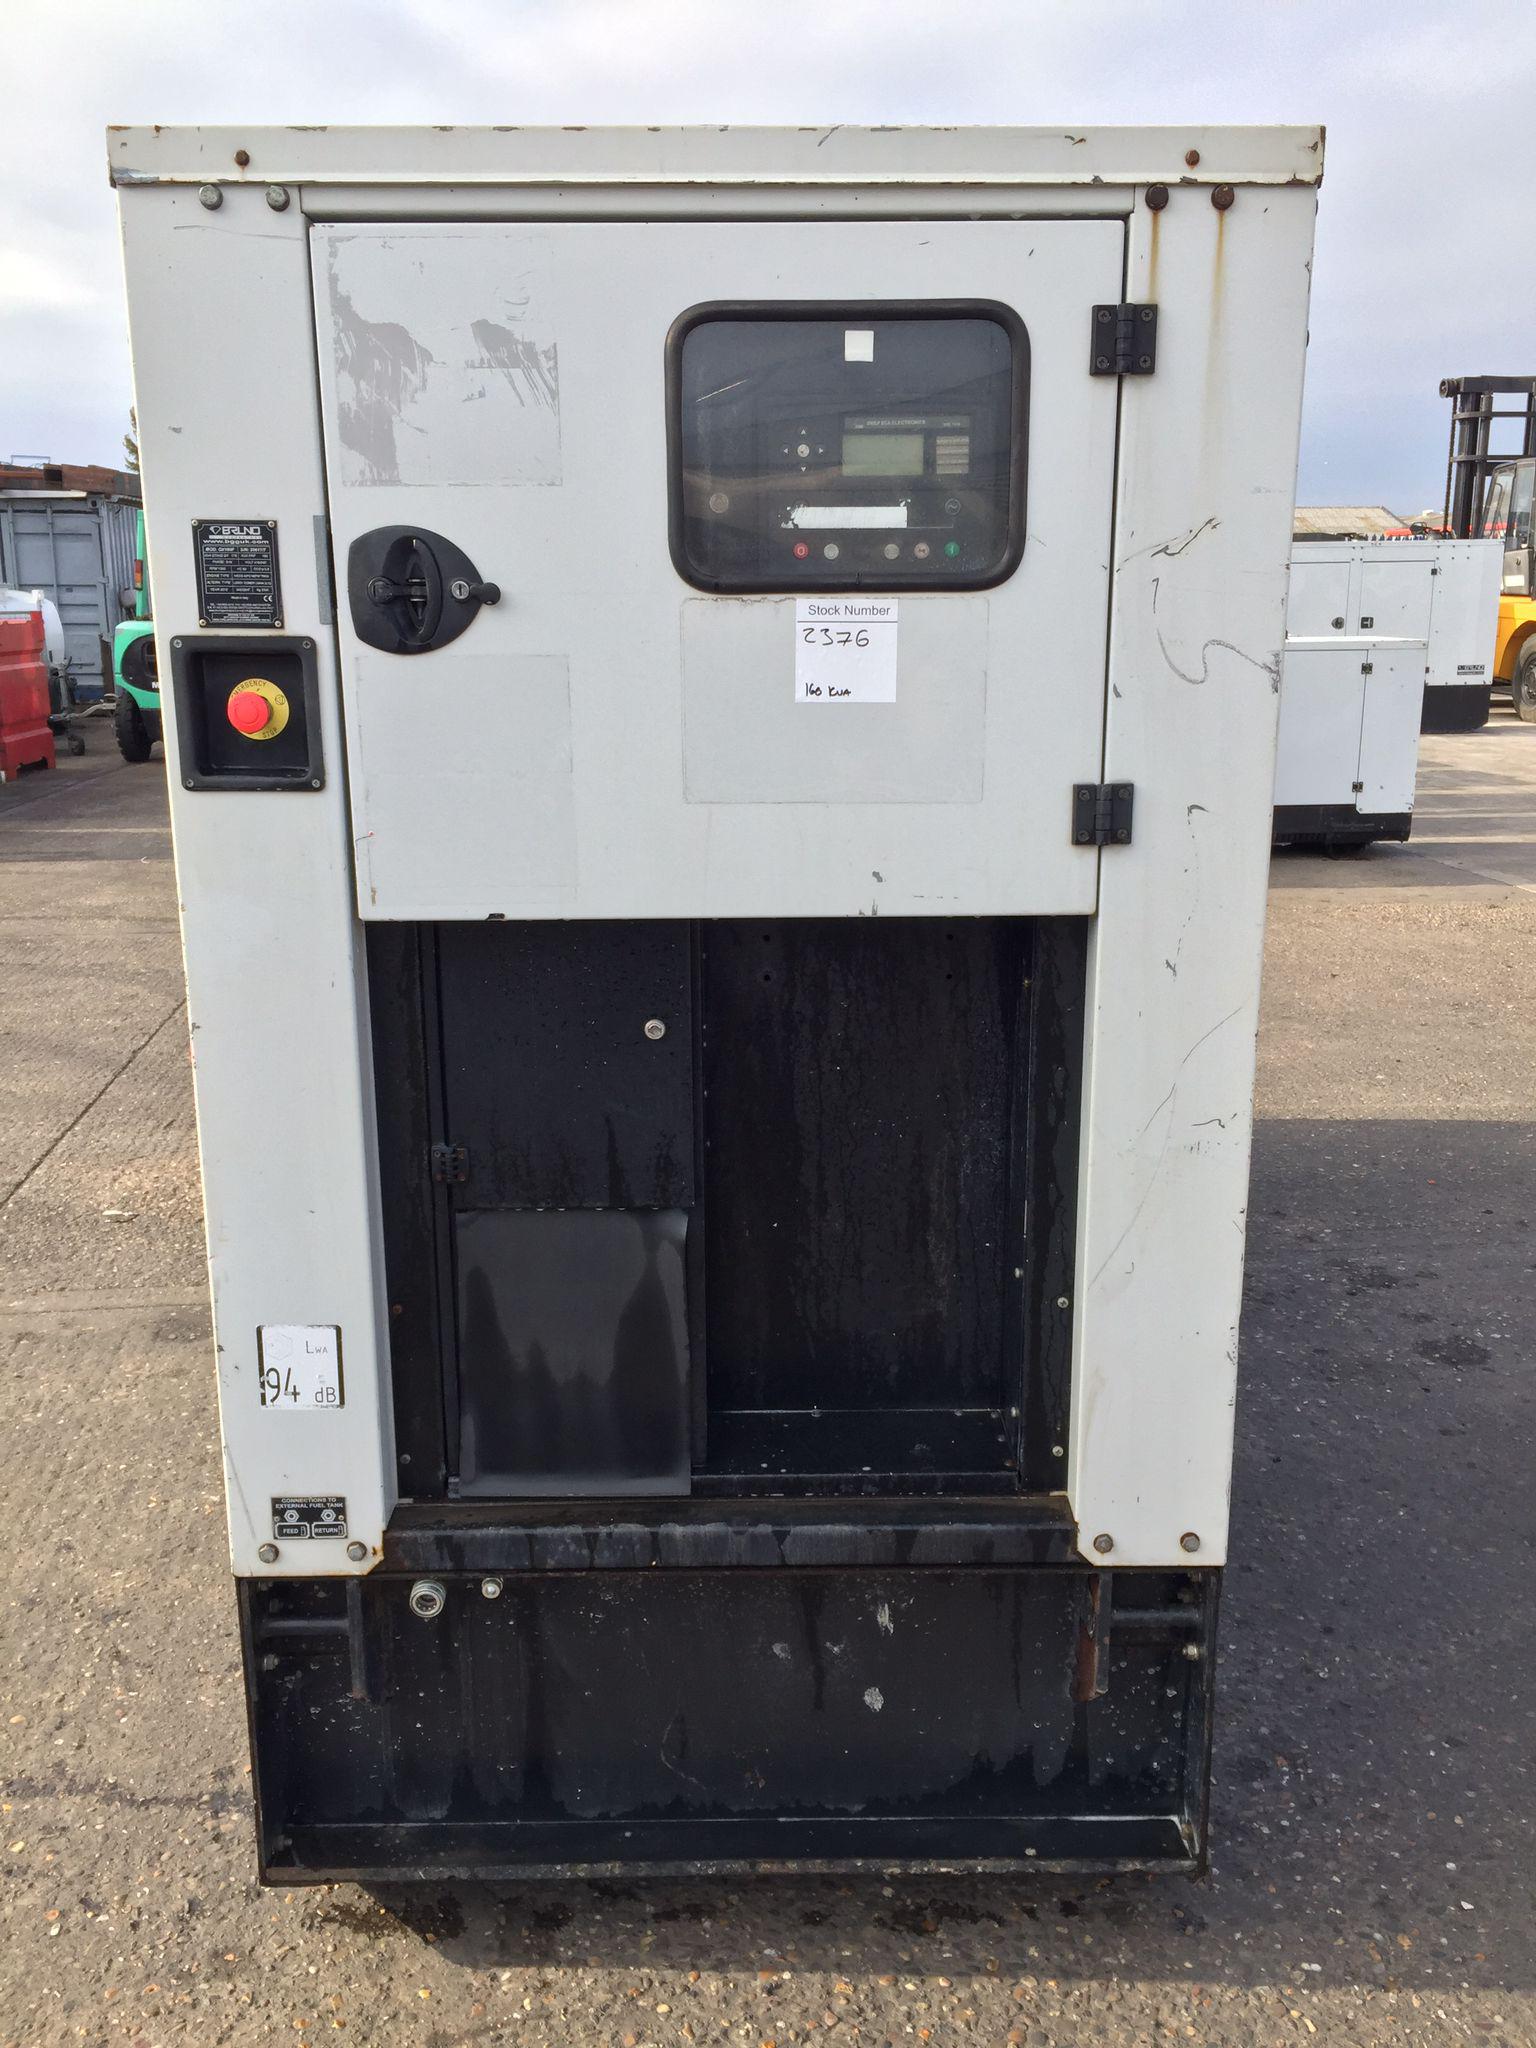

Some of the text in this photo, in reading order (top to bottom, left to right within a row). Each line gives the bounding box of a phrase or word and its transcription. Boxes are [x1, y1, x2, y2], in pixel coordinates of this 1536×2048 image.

[808, 604, 891, 616] Stock Number
[803, 627, 870, 647] 2376
[805, 682, 823, 697] 160
[265, 1367, 337, 1403] 94 dB
